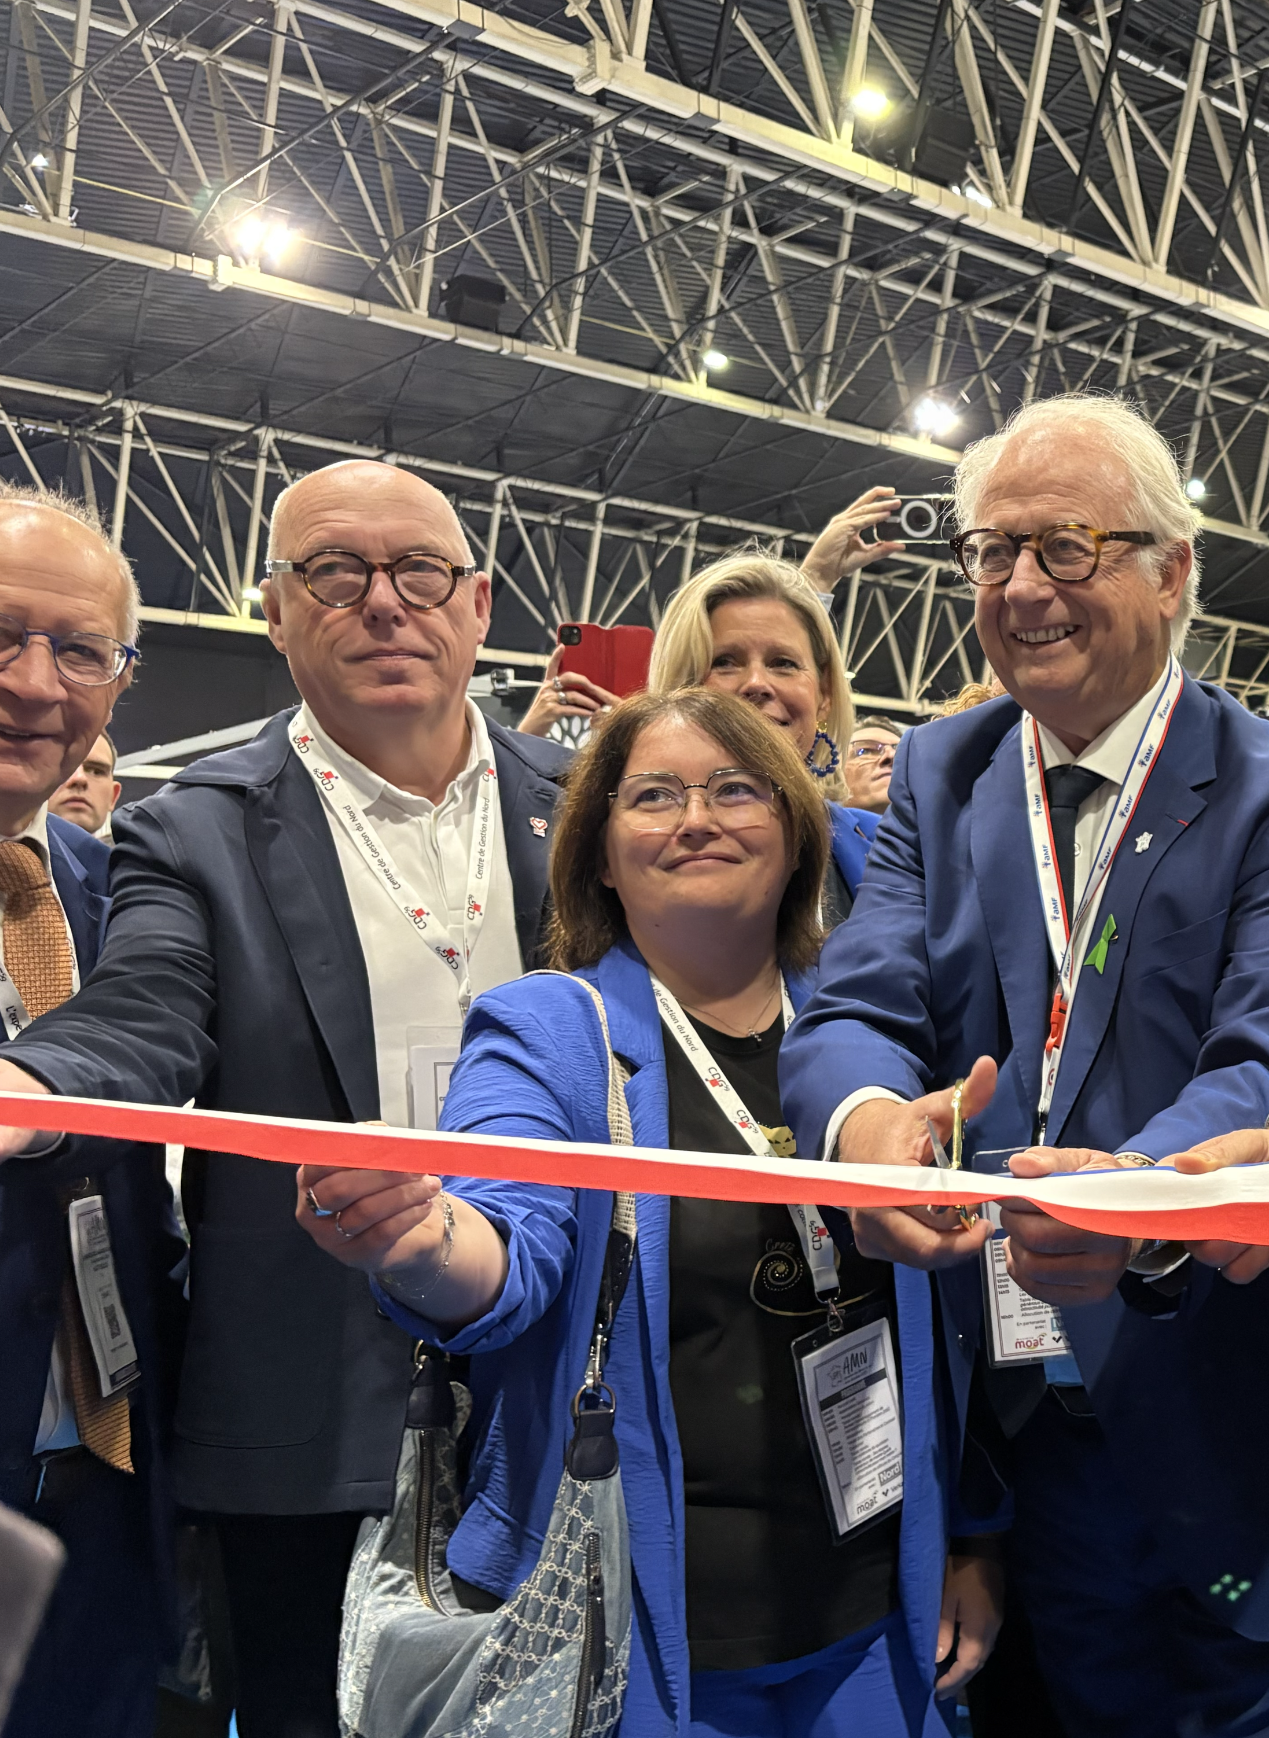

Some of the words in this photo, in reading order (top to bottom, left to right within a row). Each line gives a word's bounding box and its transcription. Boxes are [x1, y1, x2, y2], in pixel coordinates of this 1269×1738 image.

[343, 804, 359, 823] Nord
[483, 797, 491, 813] Nord
[355, 821, 365, 832] du
[482, 813, 489, 822] du
[360, 831, 383, 858] Gestion
[478, 823, 487, 848] Gestion
[479, 848, 486, 858] de
[377, 858, 386, 869] de
[475, 857, 485, 880] Centre
[383, 868, 401, 890] Centre
[659, 998, 679, 1024] Gestion
[676, 1024, 686, 1036] du
[683, 1035, 699, 1052] Nord
[1015, 1338, 1044, 1348] moat
[843, 1347, 868, 1375] AMN
[879, 1462, 900, 1482] Nord
